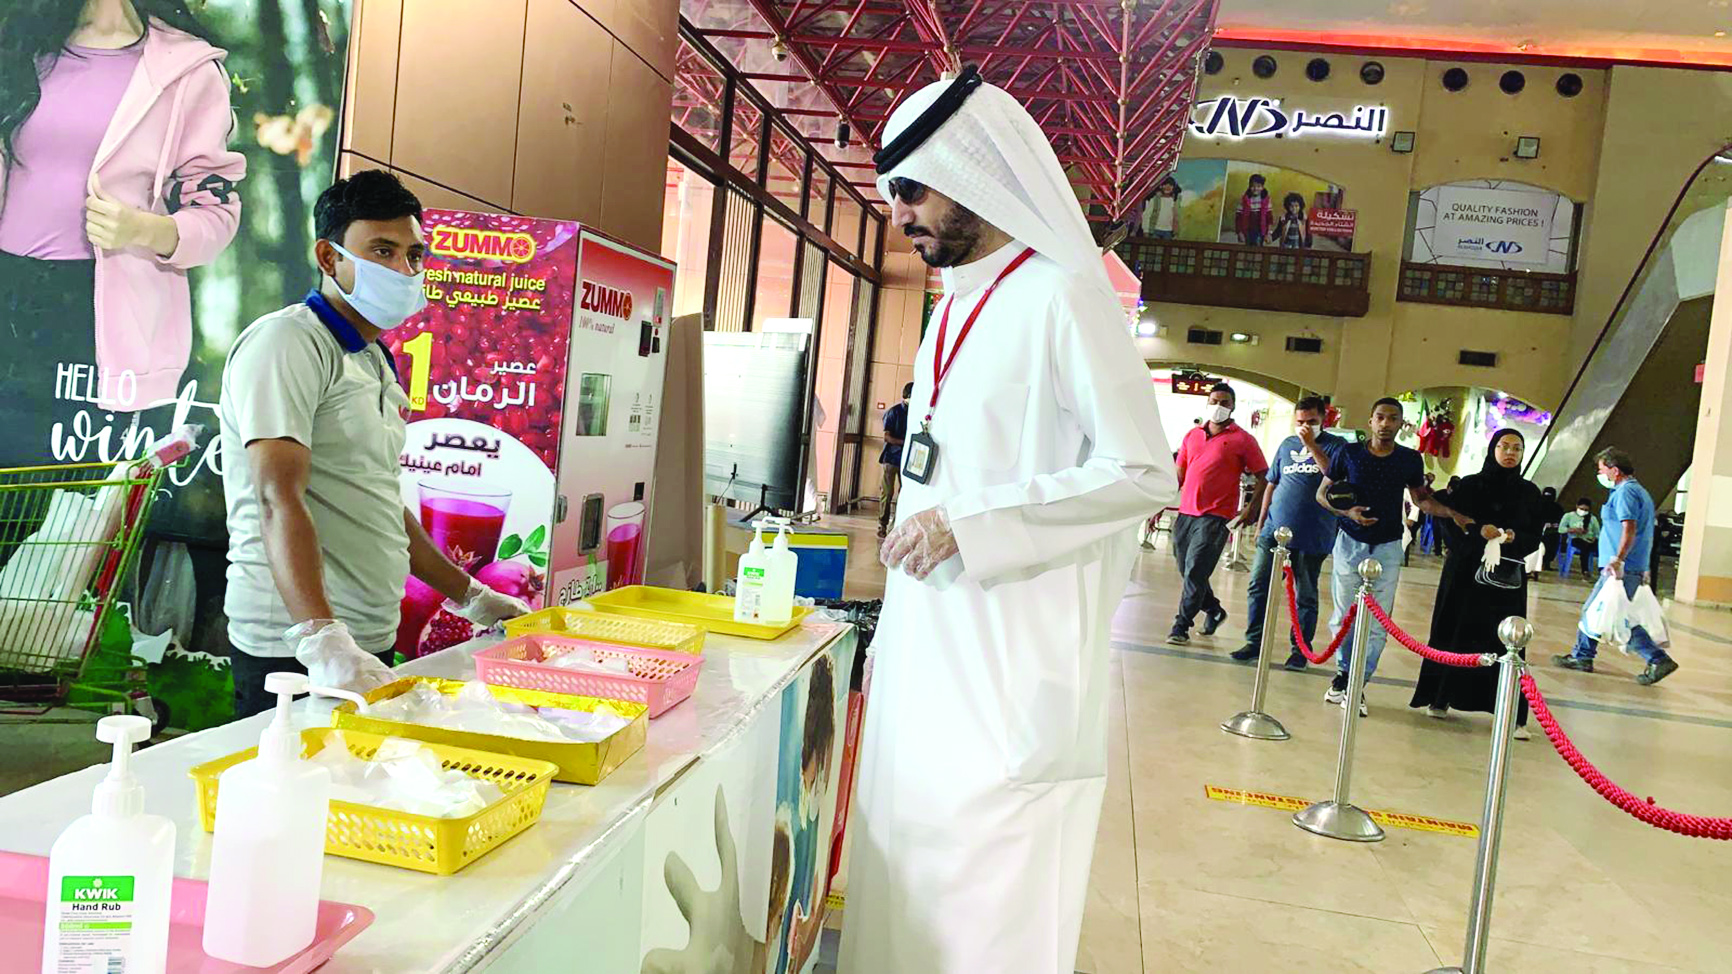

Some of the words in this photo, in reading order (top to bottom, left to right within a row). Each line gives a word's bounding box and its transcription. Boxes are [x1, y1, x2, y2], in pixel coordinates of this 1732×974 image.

[1292, 107, 1386, 133] النصر
[1452, 203, 1494, 213] QUALITY
[1495, 207, 1538, 217] FASHION
[1458, 214, 1504, 225] AMAZING
[1506, 217, 1539, 227] PRICES
[434, 230, 533, 260] ZUMMO
[423, 268, 451, 282] resh
[456, 269, 506, 288] natural
[510, 273, 546, 292] juice
[446, 289, 499, 308] طبيعي
[502, 290, 541, 311] عصير
[580, 280, 633, 321] ZUMMO
[403, 331, 433, 411] 1
[490, 358, 537, 375] عصير
[55, 363, 137, 406] HELLO
[432, 376, 536, 411] الرمان
[411, 396, 425, 405] KD
[51, 379, 222, 486] winte
[424, 432, 501, 459] يعصر
[445, 461, 482, 477] امام
[1283, 463, 1320, 474] adidas
[74, 888, 118, 900] KWIK
[72, 903, 99, 911] Hand
[101, 903, 121, 911] Rub
